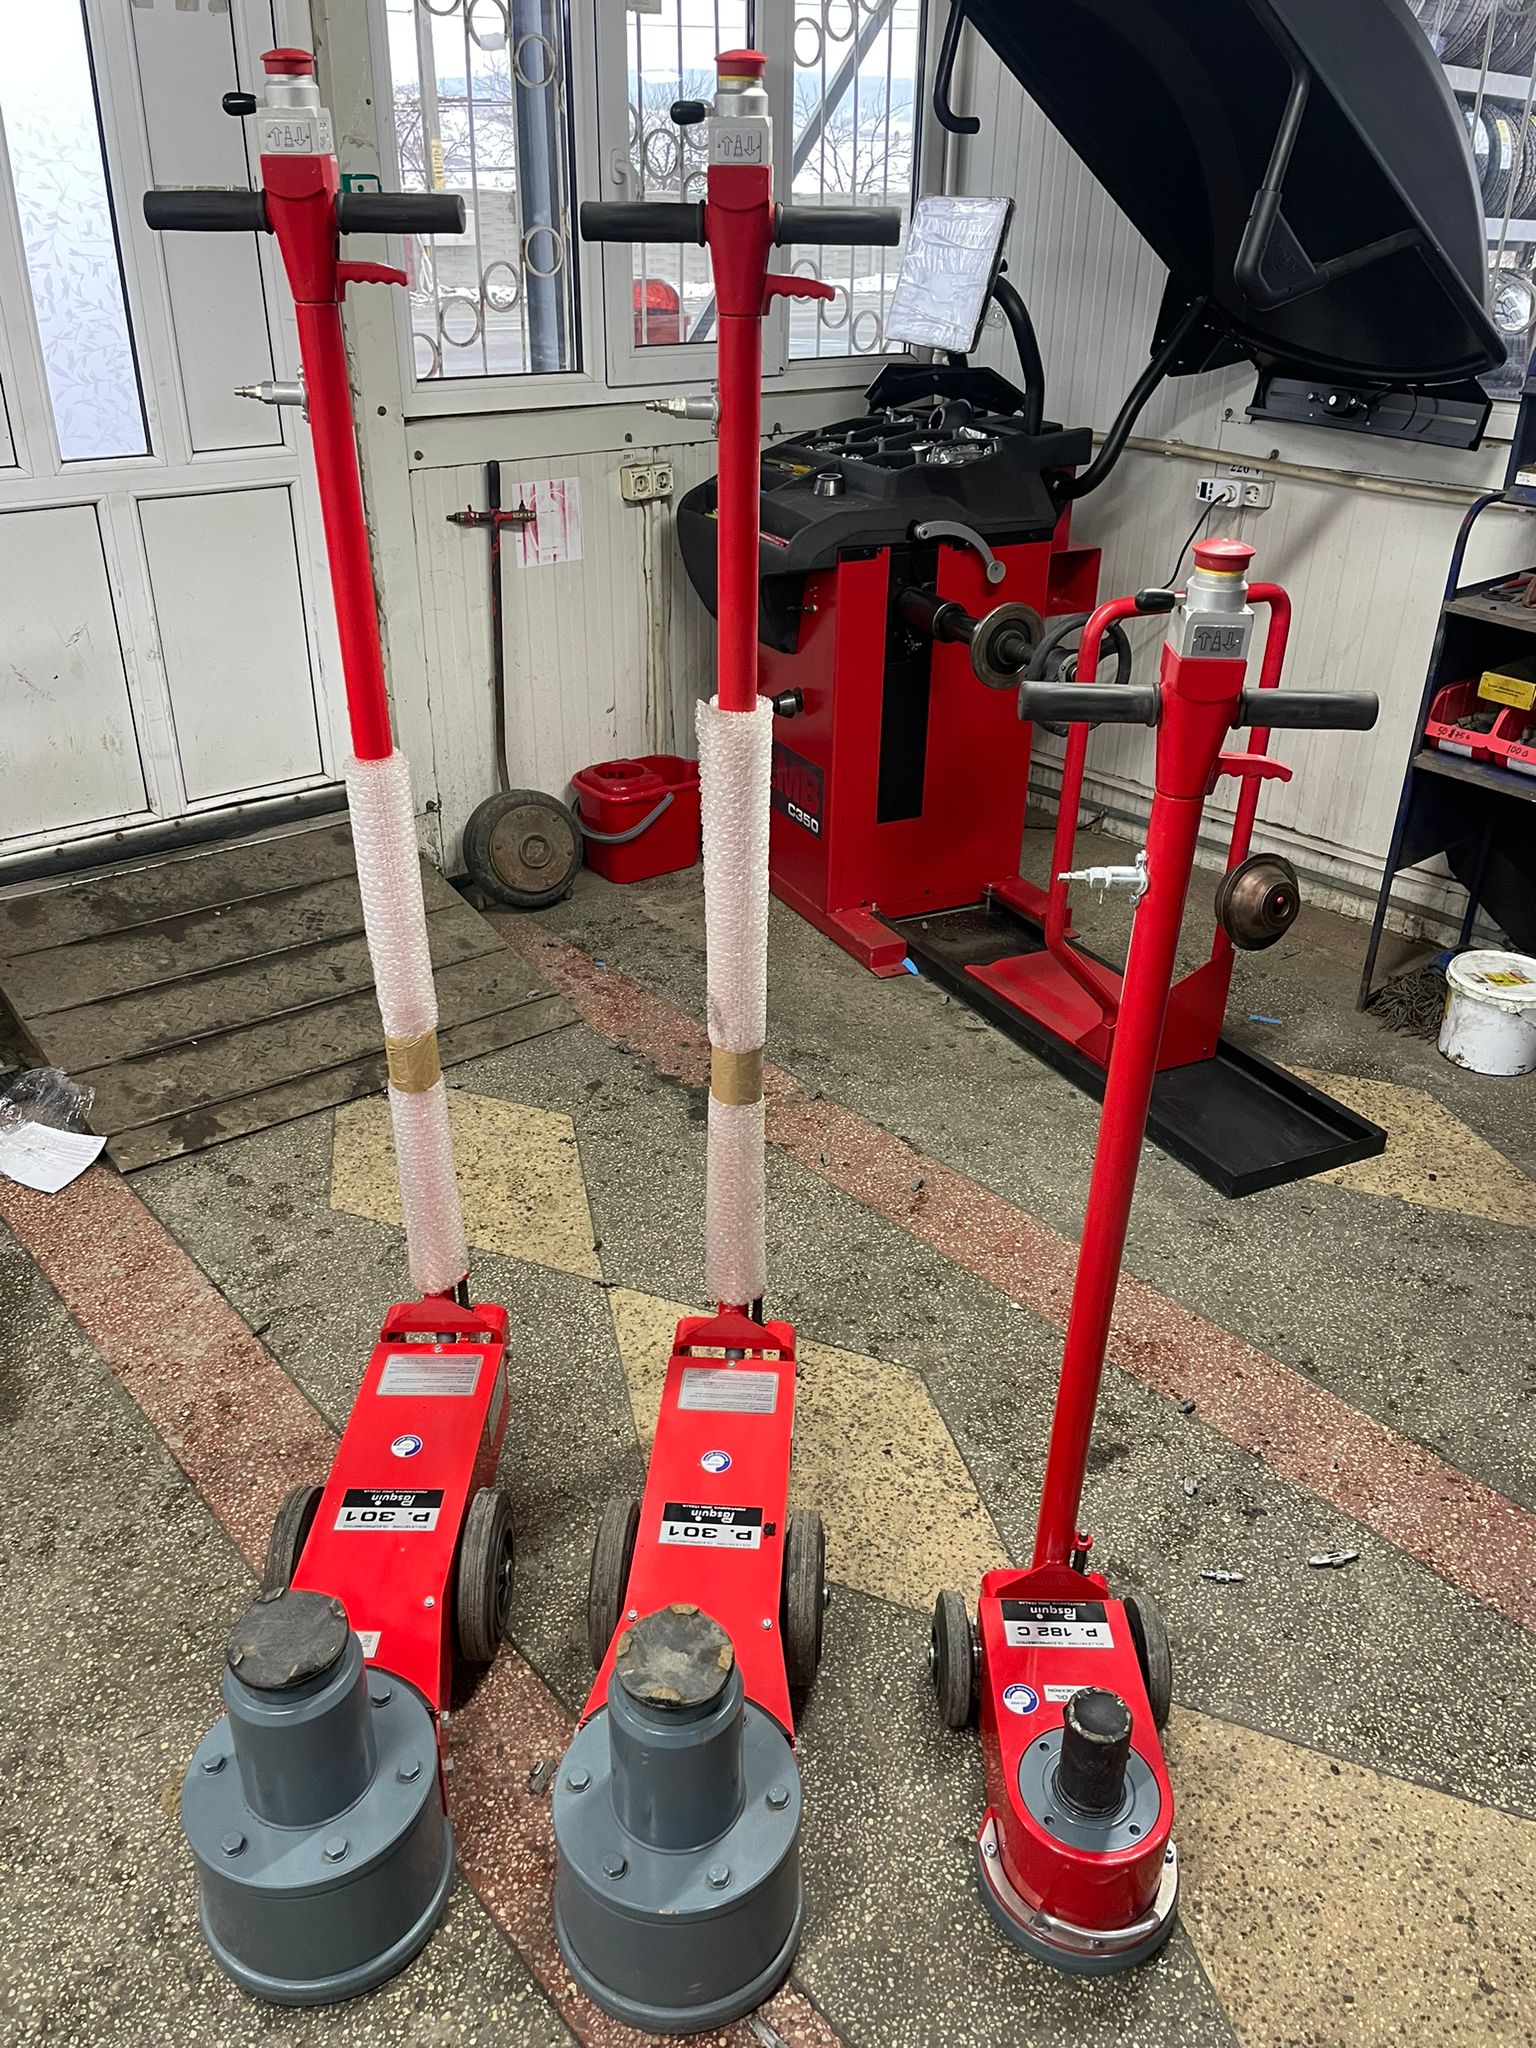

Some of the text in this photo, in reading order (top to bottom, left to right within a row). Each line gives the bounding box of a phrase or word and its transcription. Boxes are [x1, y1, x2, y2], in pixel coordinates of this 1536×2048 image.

[1437, 726, 1448, 735] 50
[1506, 745, 1521, 754] 100
[788, 802, 819, 833] C350
[371, 1494, 416, 1506] Pasquin
[345, 1512, 430, 1522] P. 301
[691, 1509, 735, 1523] Pasquin
[668, 1526, 752, 1540] P. 301
[1030, 1606, 1076, 1620] Pasquin
[1017, 1626, 1097, 1637] P. 182 C
